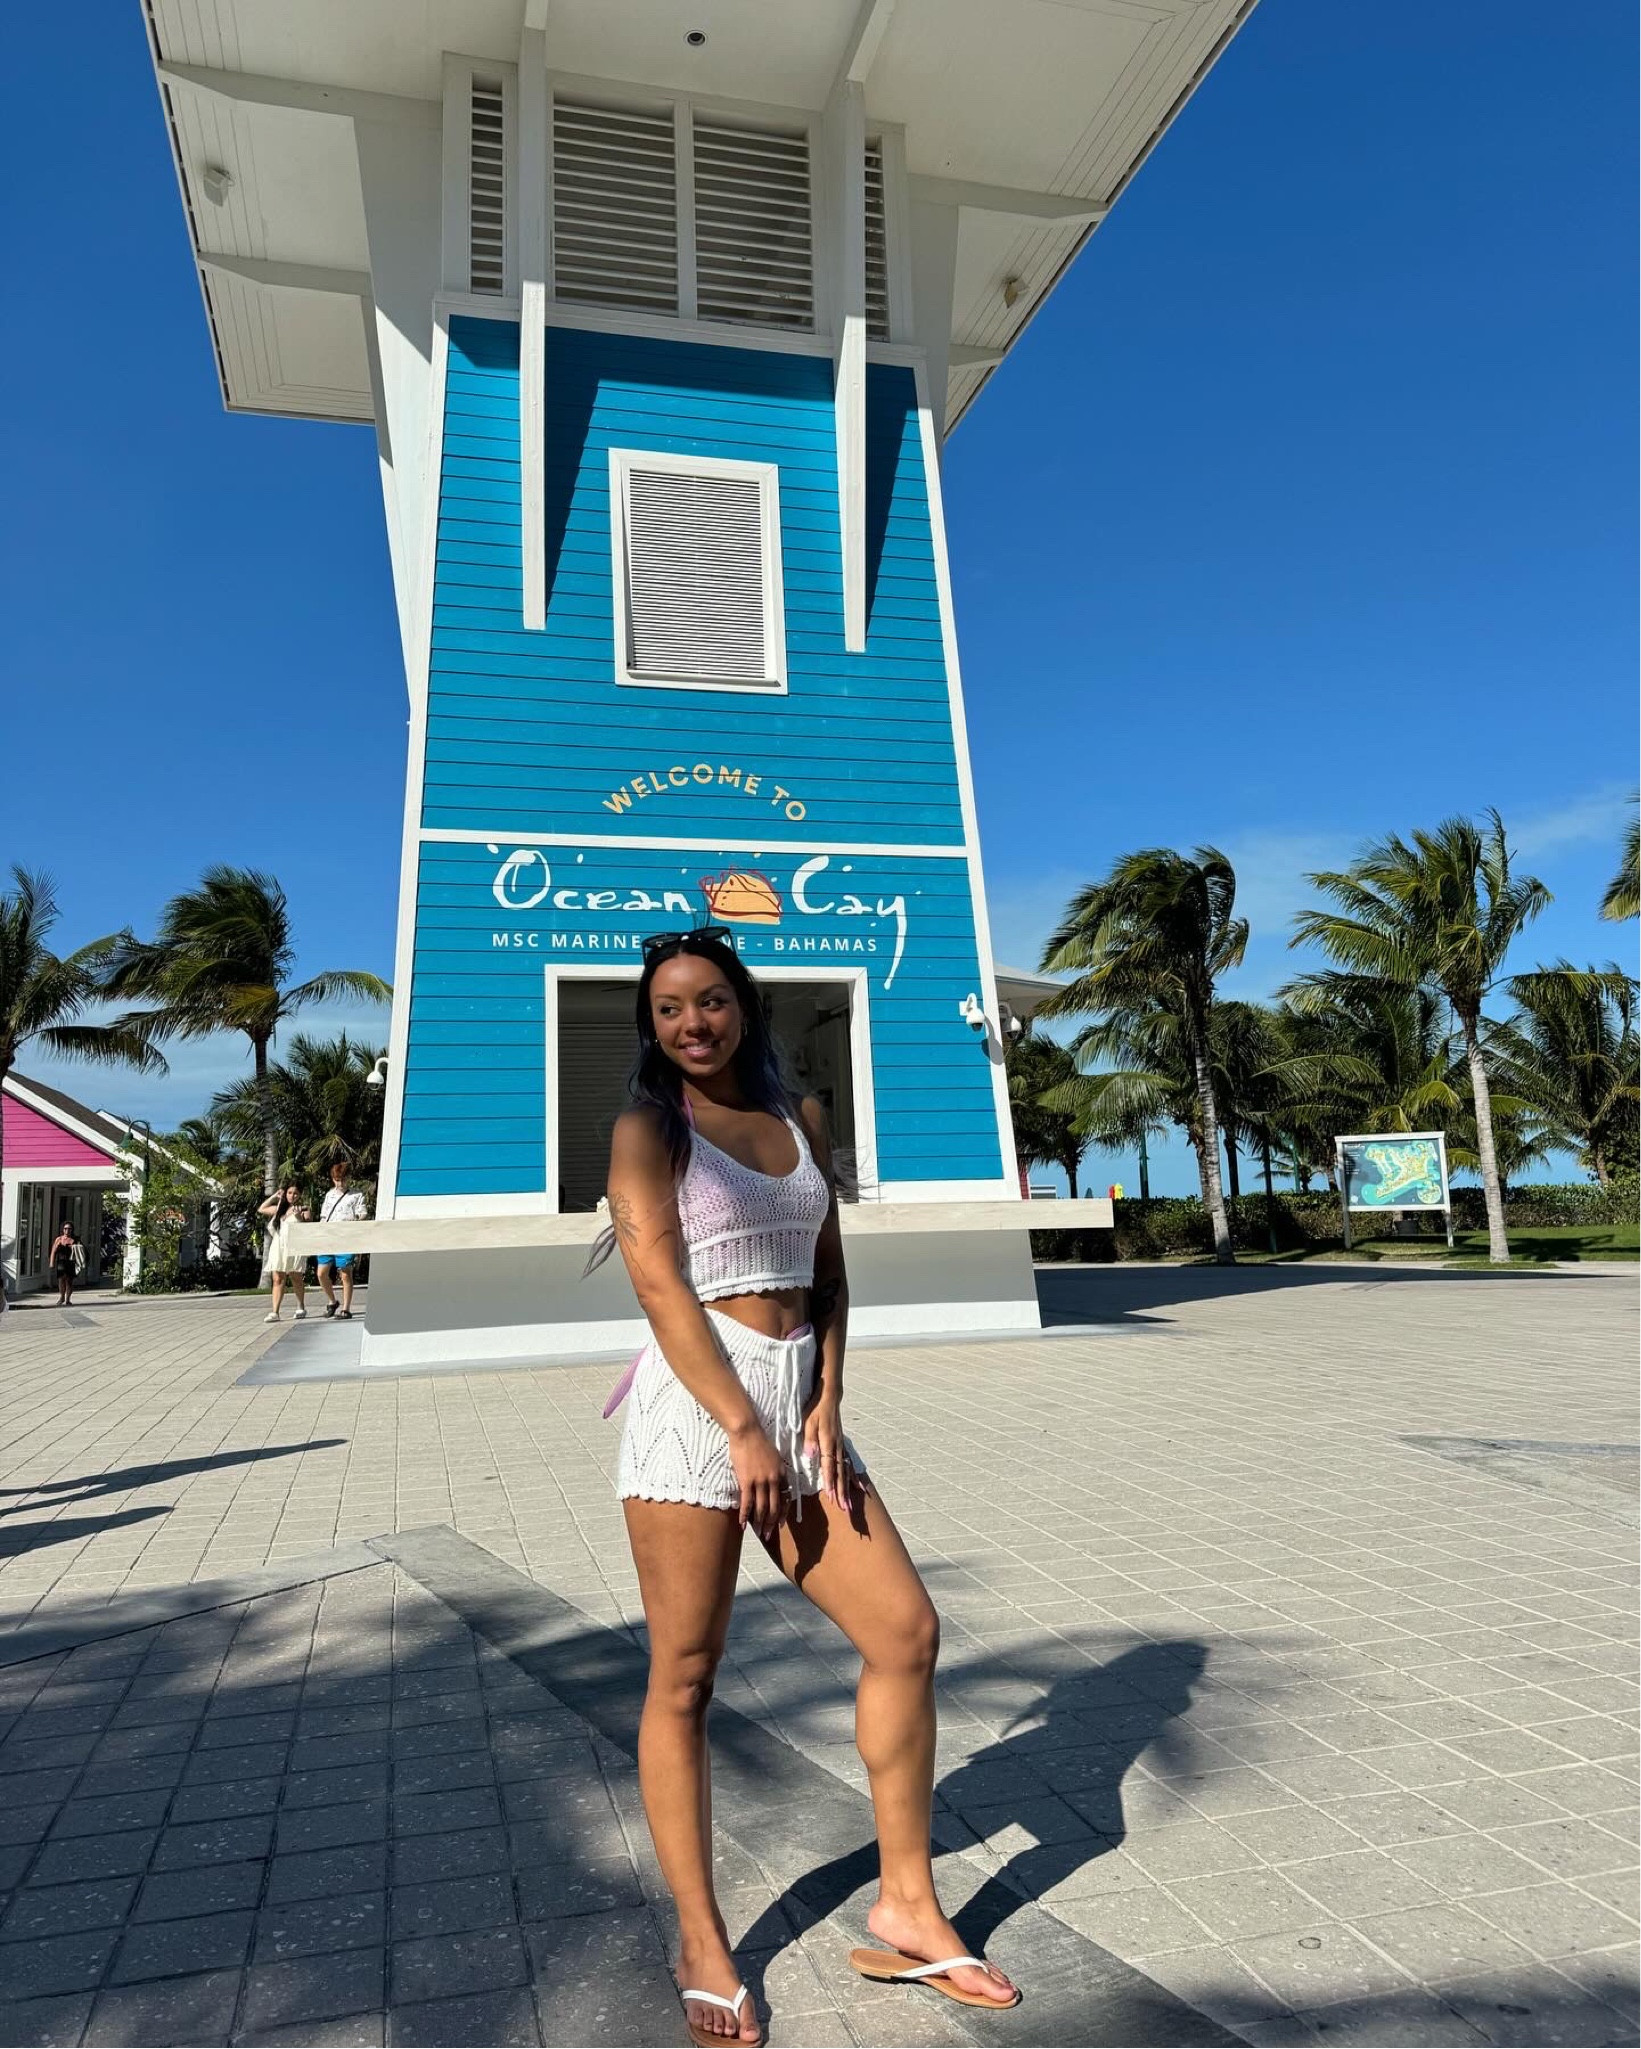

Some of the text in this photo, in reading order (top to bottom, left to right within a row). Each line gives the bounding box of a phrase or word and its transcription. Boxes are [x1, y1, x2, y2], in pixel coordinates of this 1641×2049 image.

[602, 763, 806, 821] WELCOME TO
[492, 933, 539, 947] MSC
[551, 934, 641, 949] MARINE
[774, 937, 877, 952] BAHAMAS
[493, 849, 907, 990] Ocean Cay
